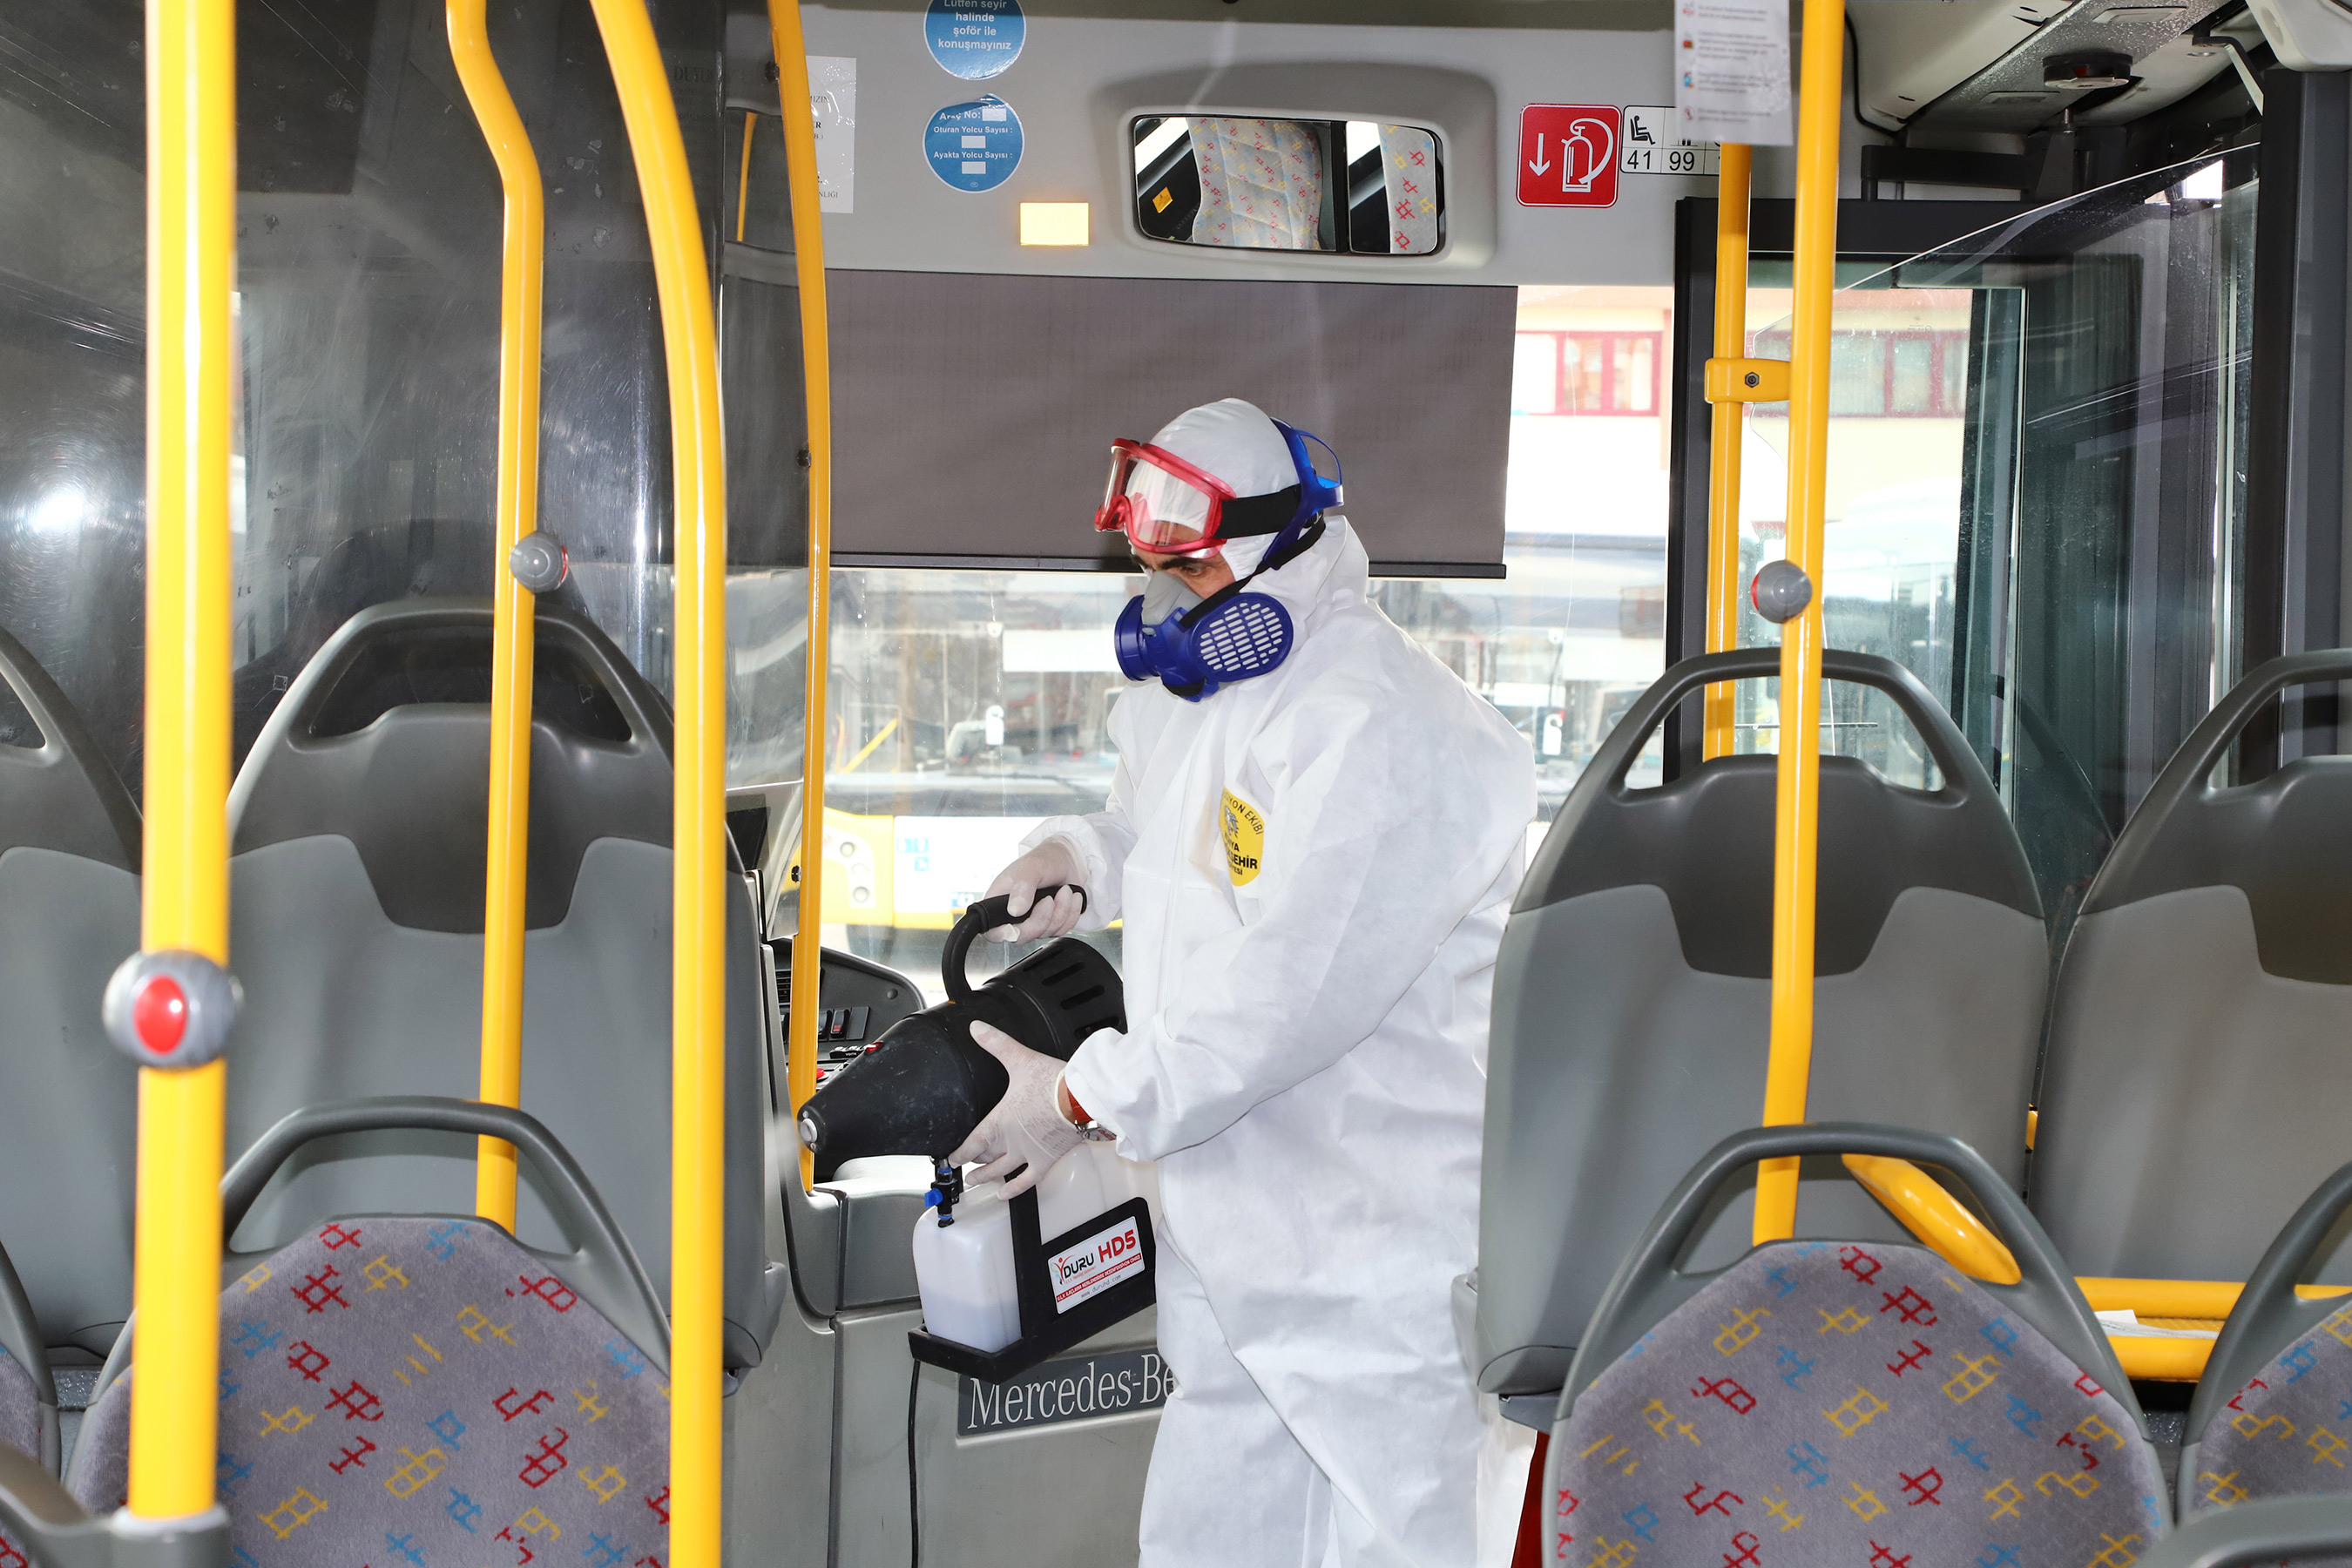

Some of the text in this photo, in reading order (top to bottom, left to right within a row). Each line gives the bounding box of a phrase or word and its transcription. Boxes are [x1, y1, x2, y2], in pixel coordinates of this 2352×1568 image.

[981, 0, 1007, 10] seyir
[956, 12, 995, 22] halinde
[953, 25, 997, 37] şoför ile
[938, 38, 1011, 51] konuşmayınız
[964, 110, 981, 118] No:
[1627, 150, 1651, 170] 41
[1669, 151, 1695, 171] 99
[1064, 1253, 1094, 1279] DURU
[1098, 1229, 1136, 1263] HD5
